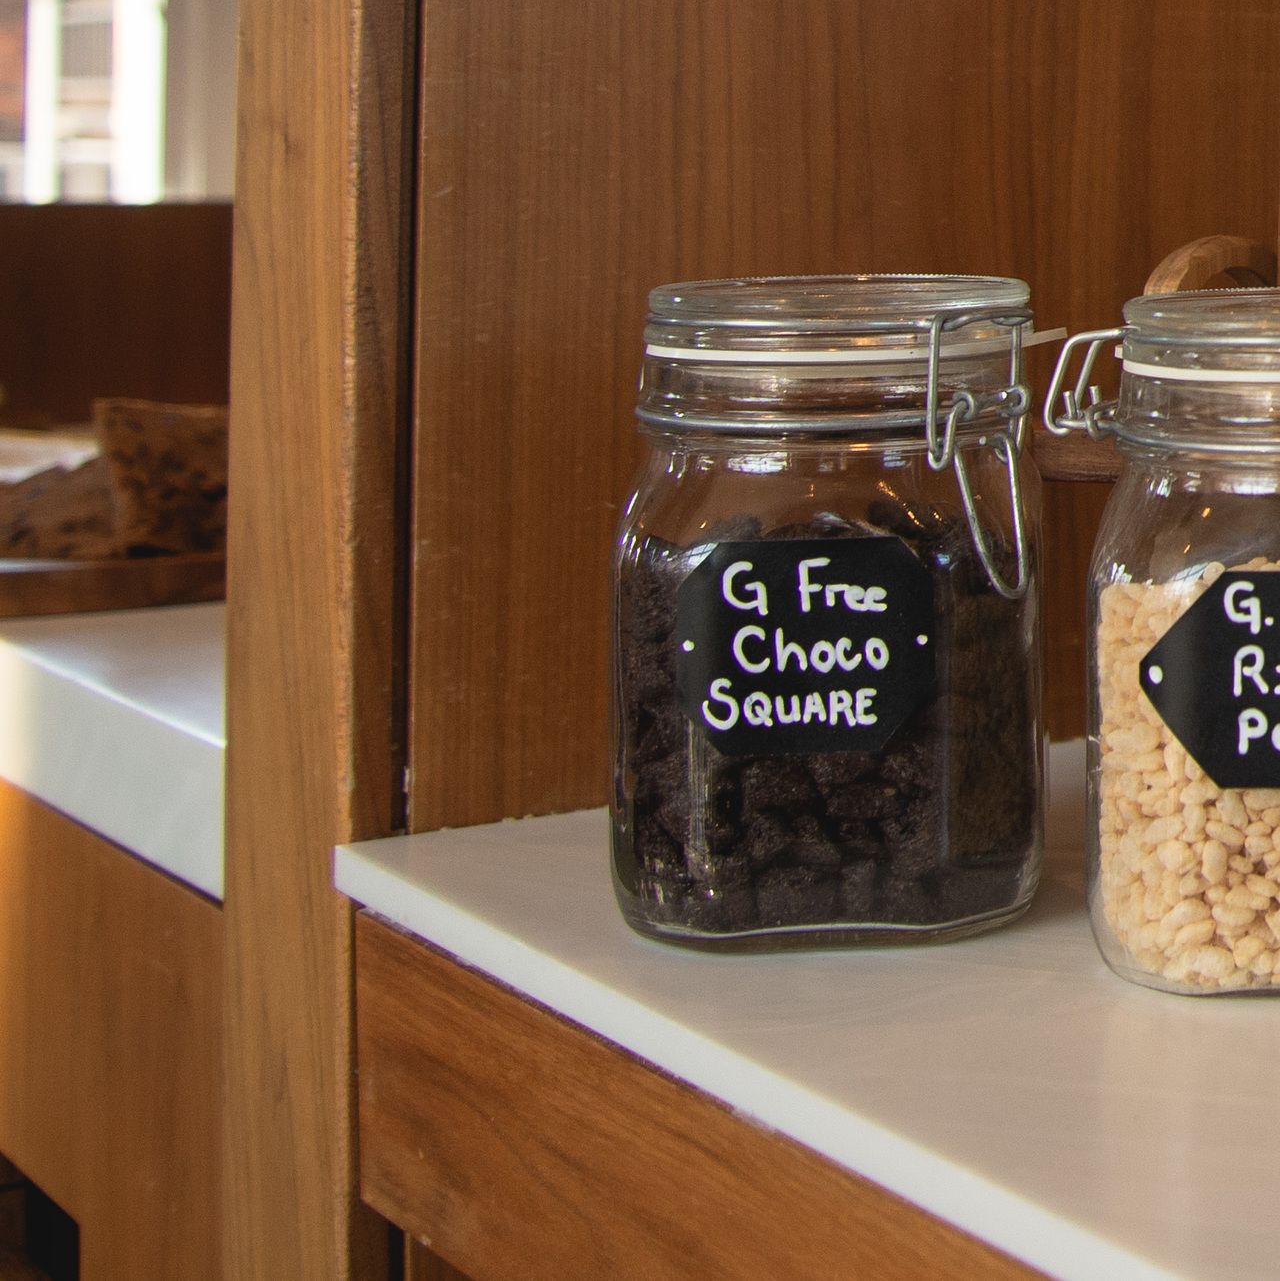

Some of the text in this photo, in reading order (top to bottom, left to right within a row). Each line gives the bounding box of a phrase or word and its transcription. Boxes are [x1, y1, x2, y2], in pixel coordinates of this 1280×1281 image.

[722, 557, 888, 616] G Free
[732, 624, 890, 674] Choco
[701, 677, 878, 731] SQUARE
